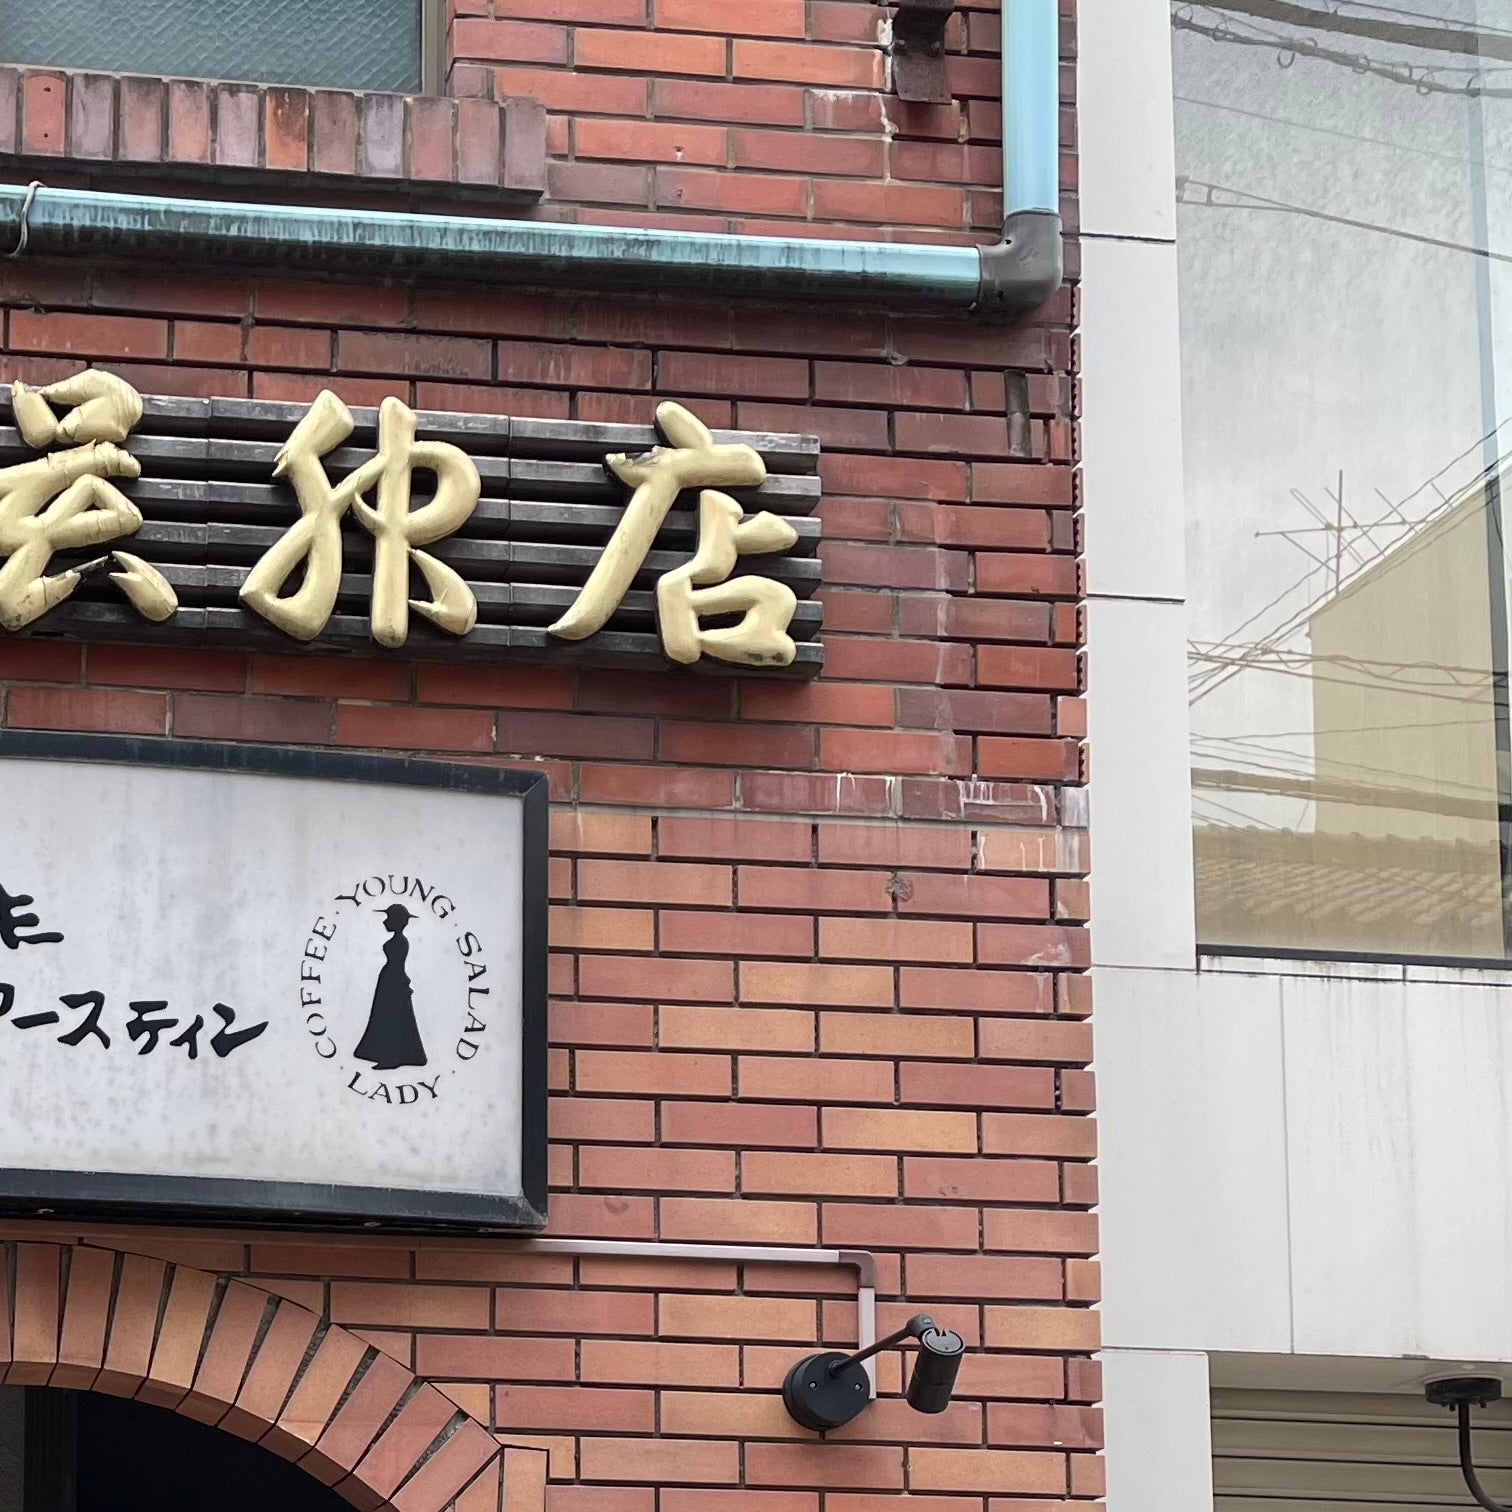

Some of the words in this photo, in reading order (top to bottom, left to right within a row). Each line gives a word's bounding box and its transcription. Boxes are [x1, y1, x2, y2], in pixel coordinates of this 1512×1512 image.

[334, 874, 457, 919] YOUNG
[300, 916, 337, 1059] COFFEE
[456, 931, 490, 1061] SALAD
[347, 1071, 441, 1105] LADY
